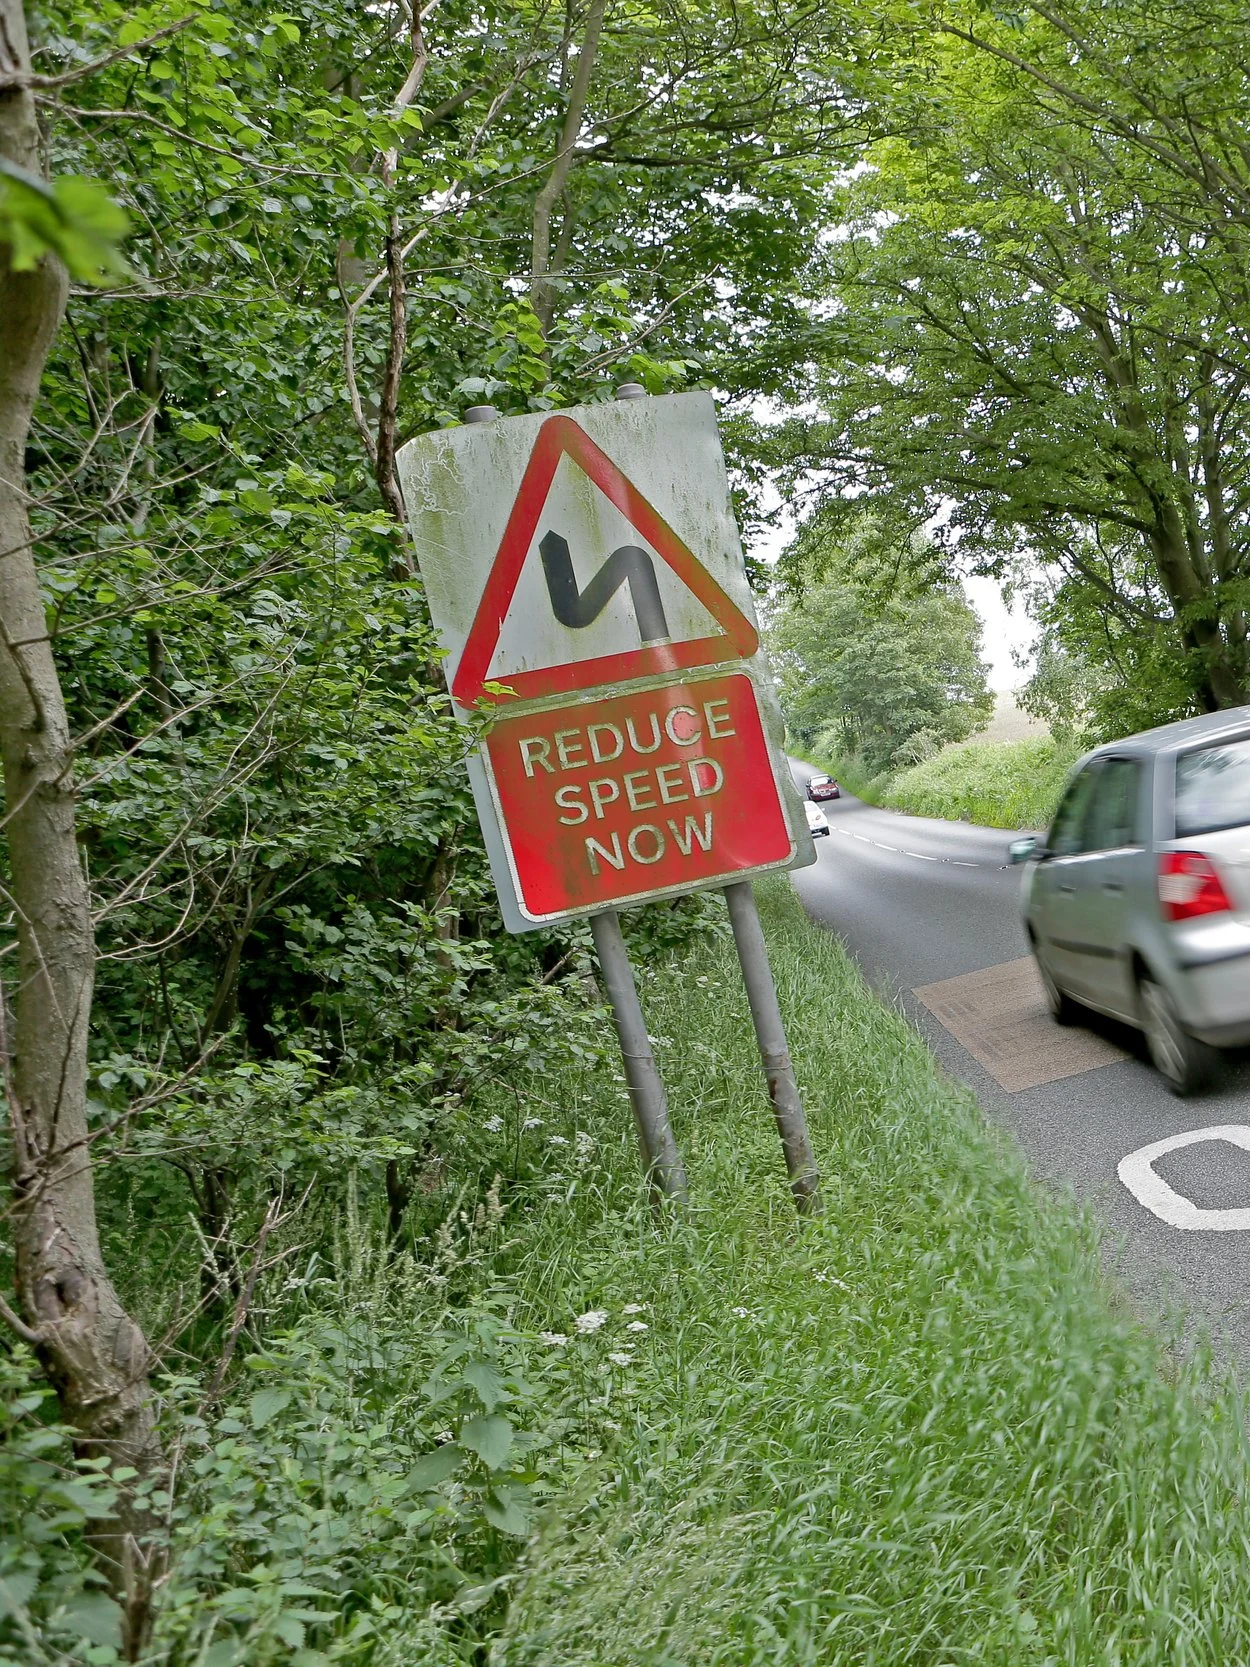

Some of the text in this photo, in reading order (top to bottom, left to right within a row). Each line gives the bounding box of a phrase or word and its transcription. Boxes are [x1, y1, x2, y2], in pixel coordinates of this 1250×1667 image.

[519, 699, 736, 778] REDUCE
[555, 757, 724, 826] SPEED
[584, 811, 714, 876] NOW
